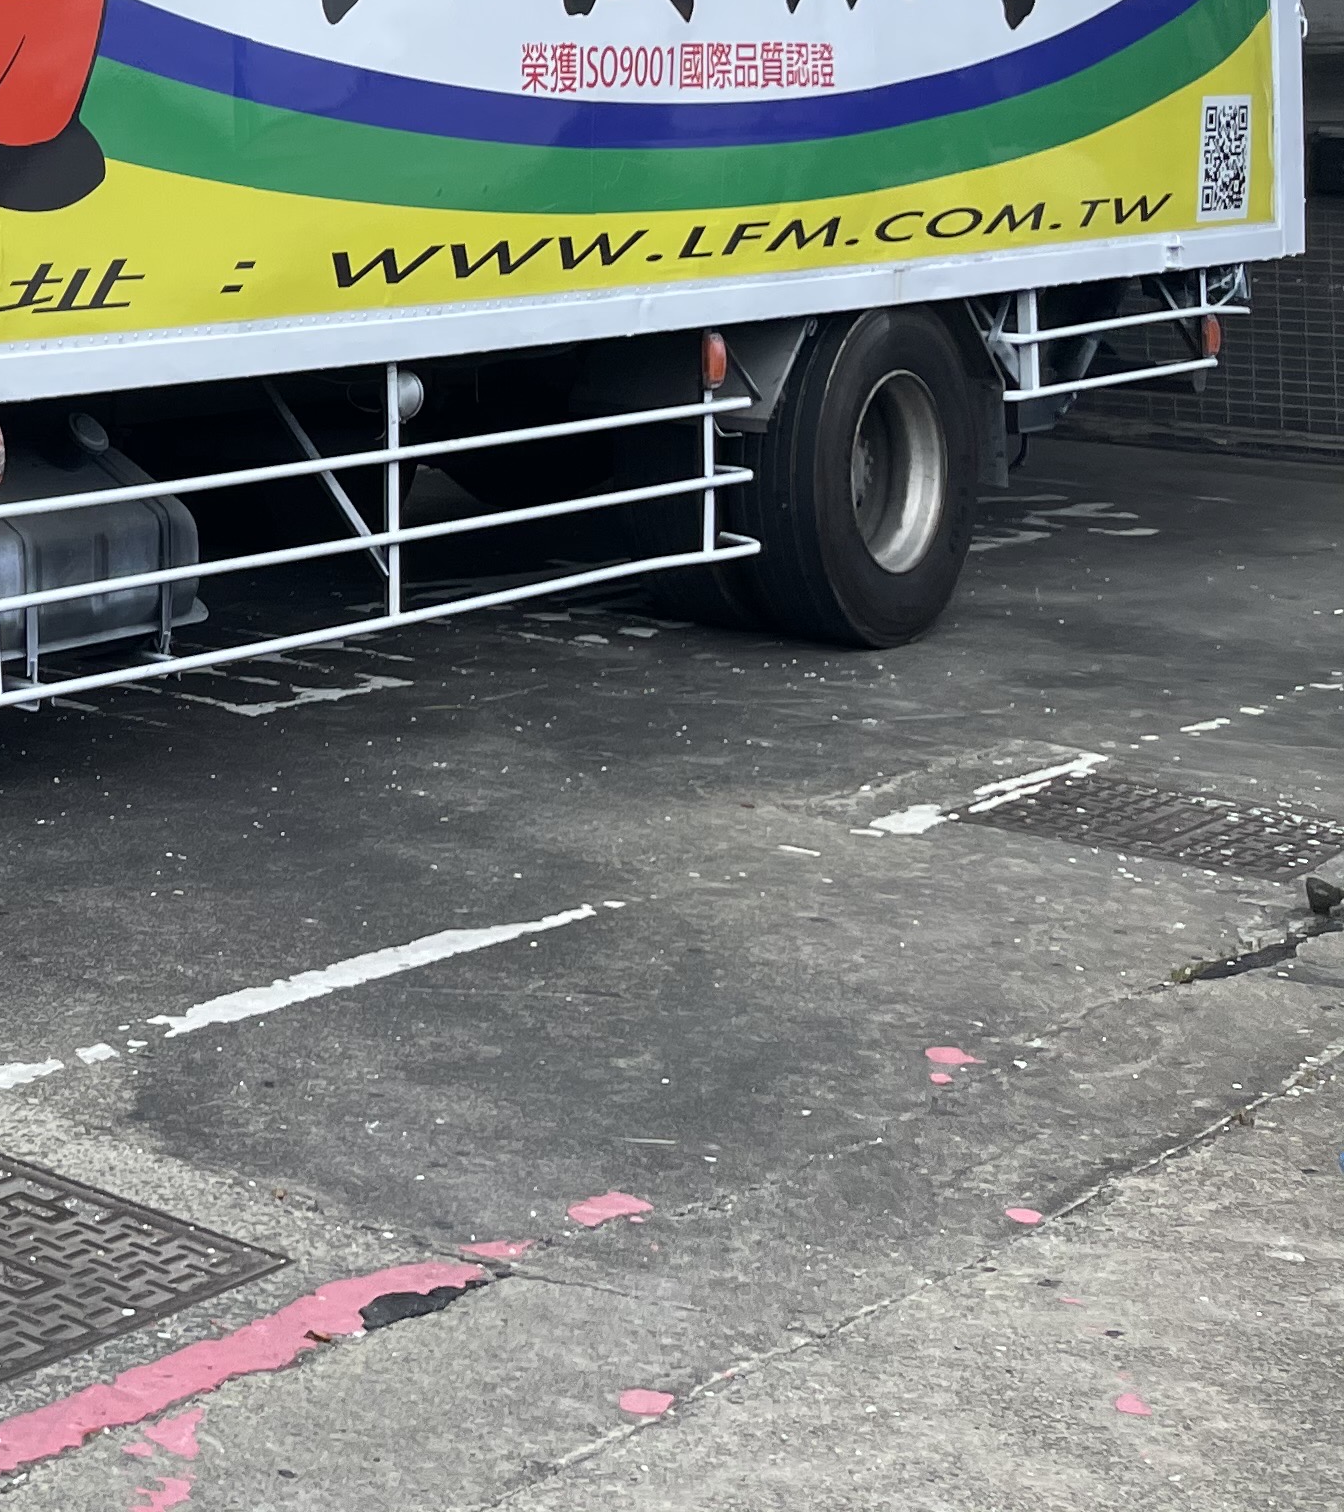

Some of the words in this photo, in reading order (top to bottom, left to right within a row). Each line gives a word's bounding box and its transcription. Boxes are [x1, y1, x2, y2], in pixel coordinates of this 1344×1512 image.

[521, 41, 836, 93] 榮獲ISO9001國際品質認證
[331, 193, 1173, 288] WWW.LFM.COM.TW
